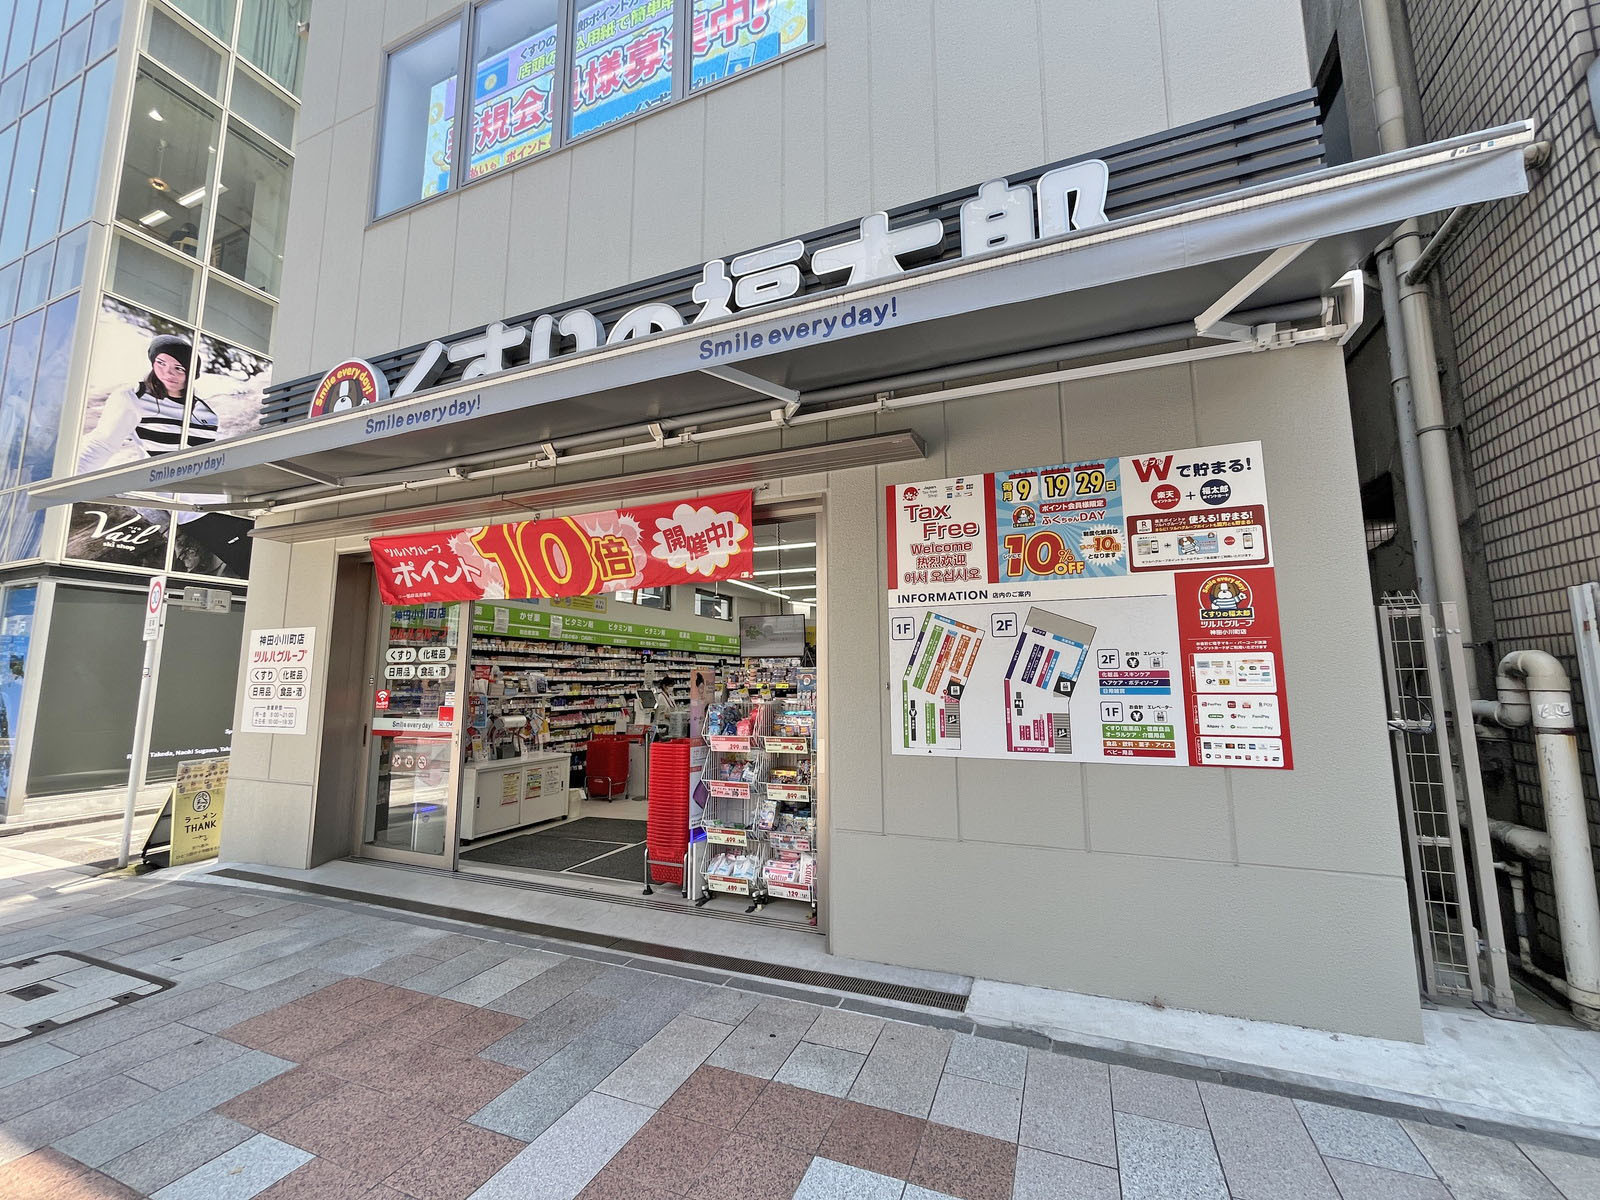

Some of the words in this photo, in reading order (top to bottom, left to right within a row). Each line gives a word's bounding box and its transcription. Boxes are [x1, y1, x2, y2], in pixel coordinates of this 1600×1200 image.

[699, 331, 764, 360] Smile
[769, 313, 834, 346] every
[840, 295, 898, 330] day!
[365, 415, 406, 435] Smile
[405, 405, 449, 427] every
[449, 394, 482, 418] day!
[149, 466, 176, 482] Smile
[175, 460, 203, 477] every
[202, 453, 226, 472] day!
[1002, 481, 1014, 502] 毎月
[1016, 478, 1032, 501] 9
[1044, 474, 1070, 498] 19
[1075, 469, 1105, 495] 29
[1105, 480, 1117, 493] 日
[1201, 485, 1229, 495] 福太郎
[1156, 490, 1174, 499] 楽天
[1041, 499, 1105, 512] ポイント会員様限定
[904, 504, 951, 523] Tax
[1041, 511, 1106, 525] ふくちゃんDAY
[1188, 514, 1220, 525] 使える!
[1220, 510, 1254, 523] 貯まる!
[922, 521, 980, 541] Free
[662, 520, 734, 561] 開催中!
[384, 544, 442, 558] ツルハグループ
[911, 542, 973, 555] Welcome
[917, 554, 967, 569] 热烈欢迎
[1087, 552, 1117, 560] となります
[1055, 561, 1086, 575] OFF
[904, 570, 928, 585] 어서
[930, 567, 982, 583] 오십시오
[1202, 579, 1217, 593] Smile
[1216, 575, 1235, 584] every
[897, 589, 989, 604] INFORMATION
[992, 589, 1032, 599] 店内のご案内
[1201, 610, 1251, 618] くすりの福太郎
[896, 623, 911, 635] 1F
[996, 619, 1013, 632] 2F
[1200, 619, 1255, 628] ツルハグループ
[259, 633, 305, 646] 神田小川町店
[254, 649, 308, 663] ツルハグループ
[390, 650, 412, 660] くすり
[423, 649, 446, 659] 化粧品
[643, 655, 648, 663] 2
[1101, 654, 1116, 664] 2F
[254, 670, 273, 681] くすり
[282, 670, 303, 680] 化粧品
[388, 667, 410, 678] 日用品
[420, 666, 446, 677] 食品・酒
[252, 686, 272, 697] 日用品
[280, 686, 303, 697] 食品・酒
[1105, 707, 1119, 717] 1F
[184, 812, 217, 824] ラーメン
[184, 820, 217, 834] THANK
